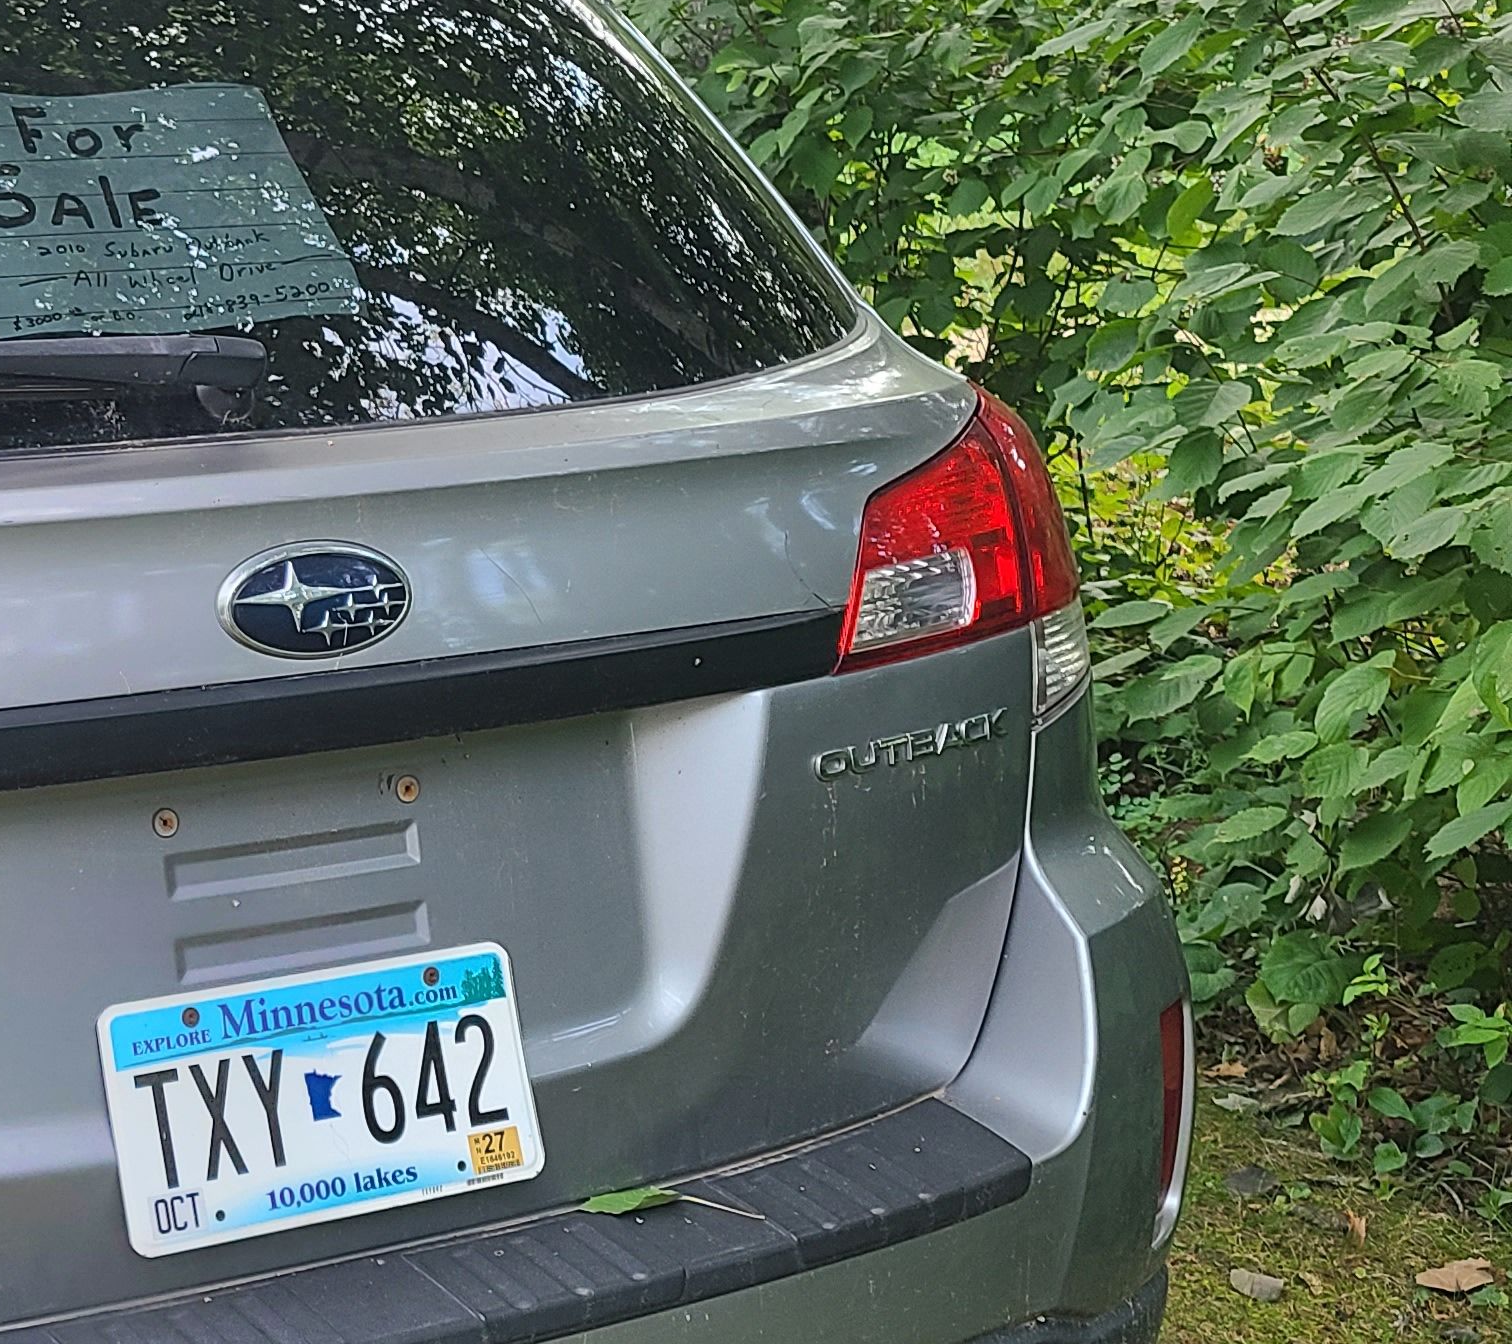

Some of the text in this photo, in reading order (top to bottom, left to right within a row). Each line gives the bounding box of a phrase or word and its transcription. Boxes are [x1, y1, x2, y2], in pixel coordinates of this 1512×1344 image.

[10, 105, 145, 157] For
[38, 242, 86, 256] 2010
[74, 270, 108, 287] All
[219, 261, 277, 282] Drive
[132, 983, 458, 1056] EXPLORE Minnesota.com
[134, 1014, 510, 1190] TXY 642
[482, 1131, 505, 1154] 27
[266, 1165, 418, 1211] 10,000 lakes
[154, 1192, 200, 1234] OCT
